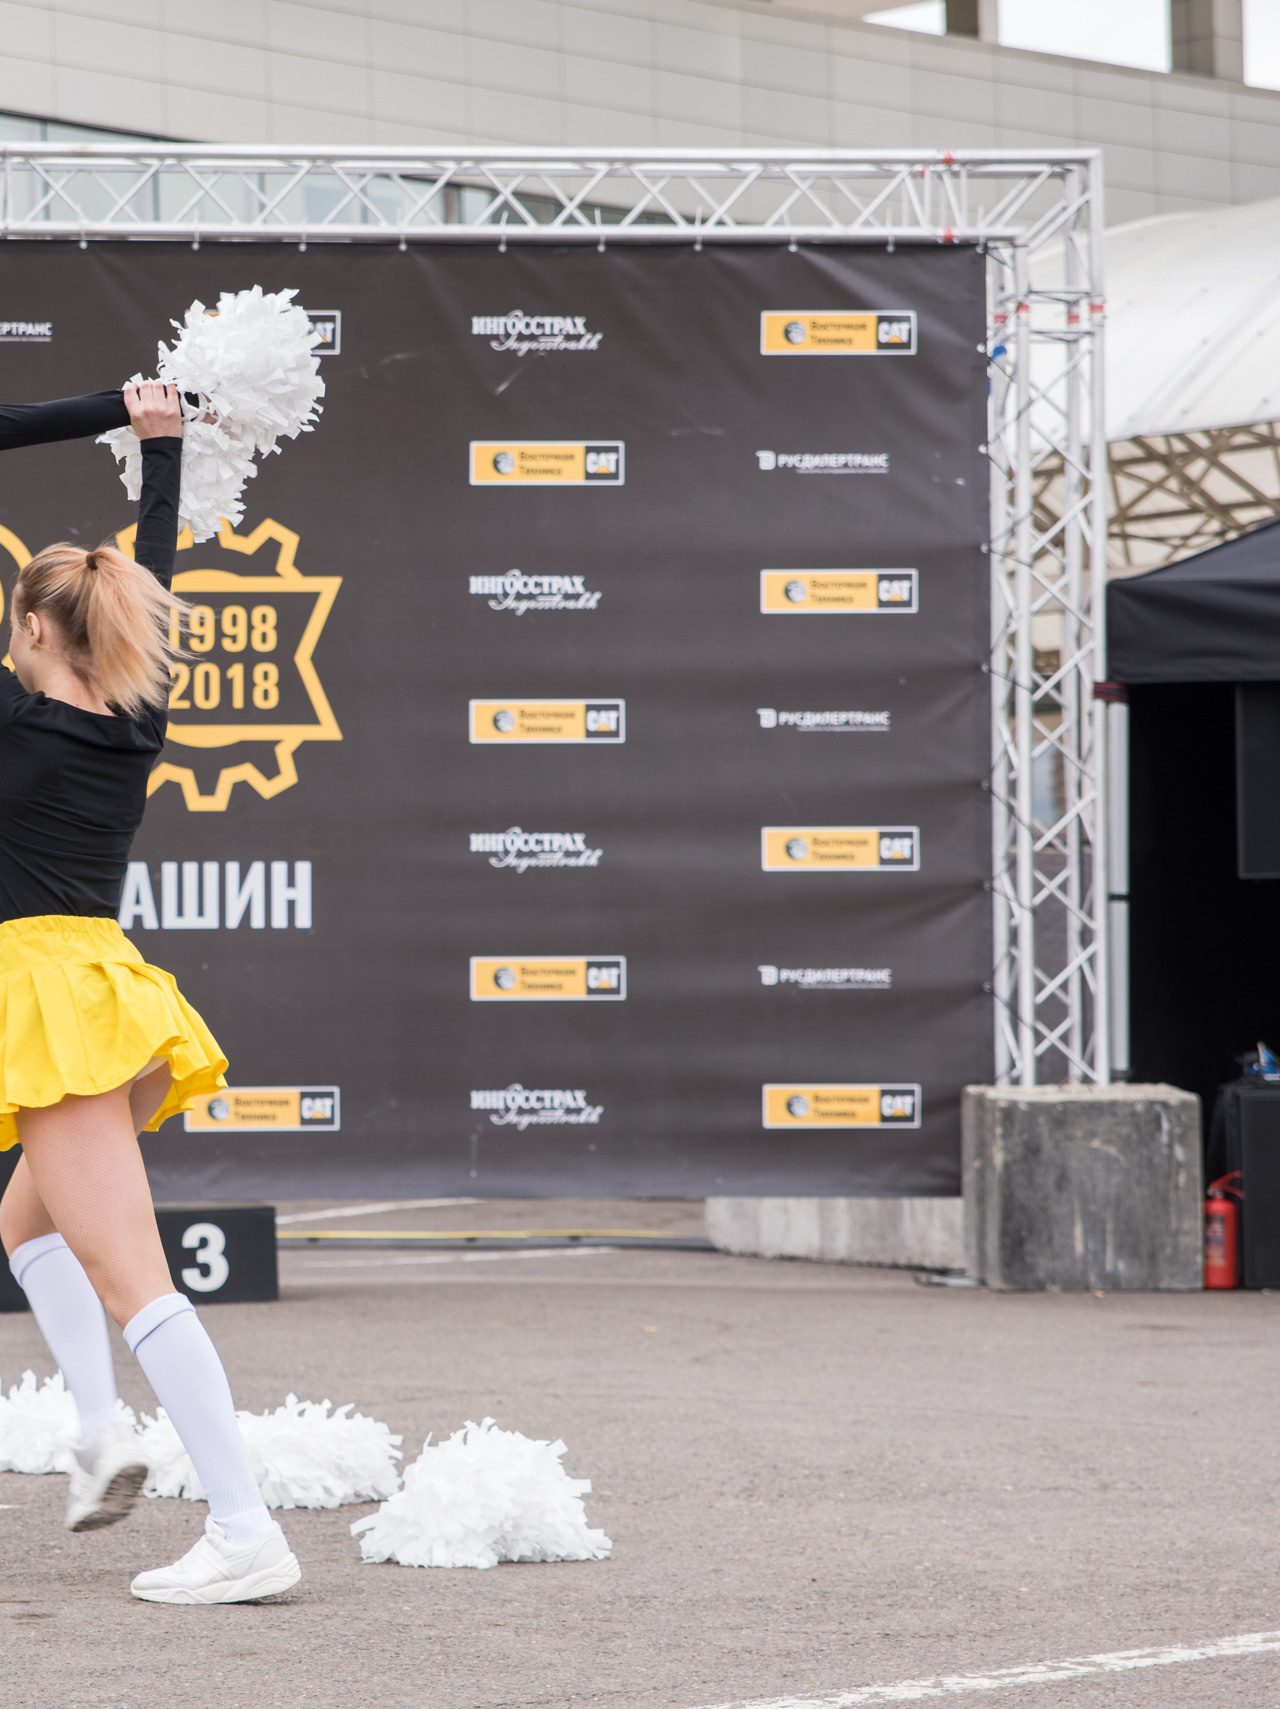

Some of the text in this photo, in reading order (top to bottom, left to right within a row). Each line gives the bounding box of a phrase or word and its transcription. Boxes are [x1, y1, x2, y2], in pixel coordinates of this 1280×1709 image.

[471, 314, 587, 335] ИНГОССТРАХ
[877, 321, 911, 344] CAT
[586, 452, 619, 473] CAT
[469, 573, 585, 594] ИНГОССТРАХ
[878, 579, 912, 602] CAT
[170, 604, 278, 653] 1998
[168, 662, 280, 710] 2018
[586, 710, 619, 732] CAT
[469, 831, 586, 852] ИНГОССТРАХ
[879, 837, 913, 859] CAT
[117, 861, 313, 930] АШИН
[586, 967, 620, 989] CAT
[300, 1097, 334, 1119] CAT
[470, 1088, 587, 1109] ИНГОССТРАХ
[880, 1094, 914, 1117] CAT
[181, 1222, 229, 1292] 3
